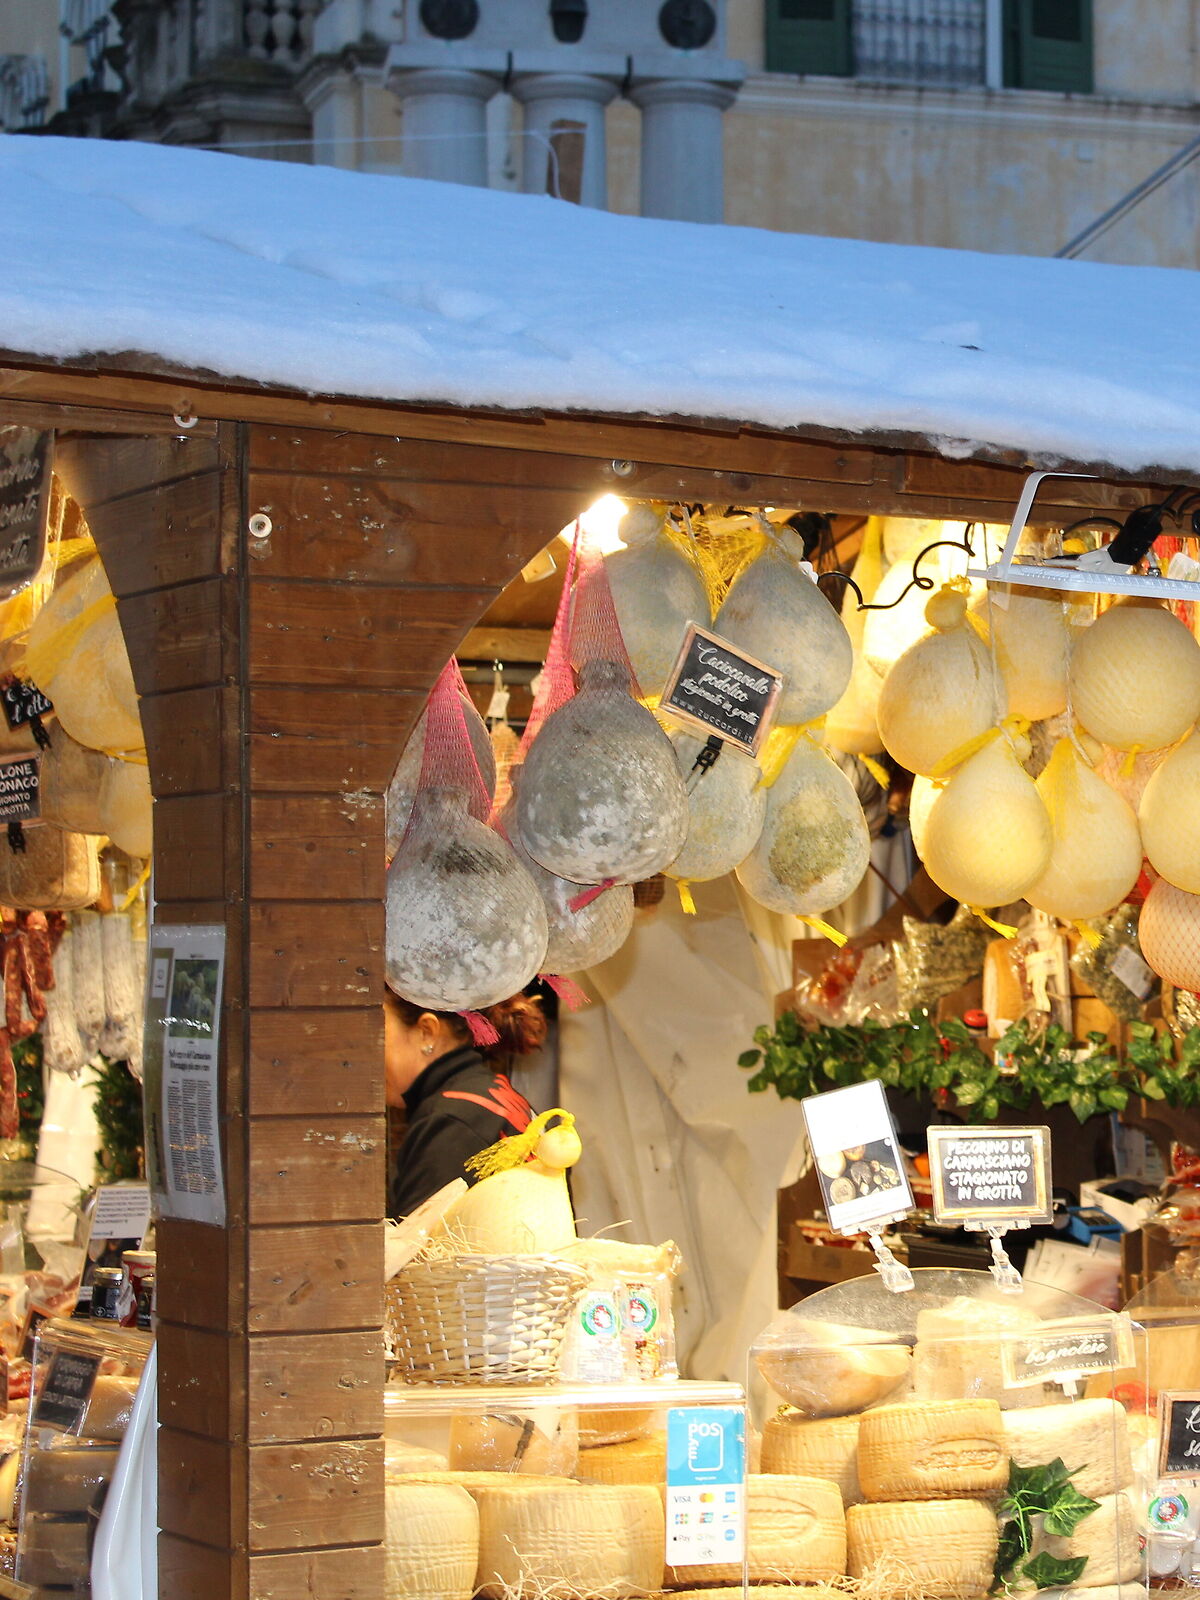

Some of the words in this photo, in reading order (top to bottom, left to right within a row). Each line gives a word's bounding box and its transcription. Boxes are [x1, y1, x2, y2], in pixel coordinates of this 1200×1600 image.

[697, 642, 769, 695] Caciocavallo
[697, 672, 749, 702] podolico
[0, 763, 32, 780] LONE
[0, 776, 39, 793] ONACO
[946, 1140, 1009, 1156] PECORINO
[1011, 1140, 1025, 1154] DI
[949, 1170, 1028, 1187] STAGIONATO
[957, 1186, 972, 1200] IN
[974, 1184, 1022, 1200] GROTTA
